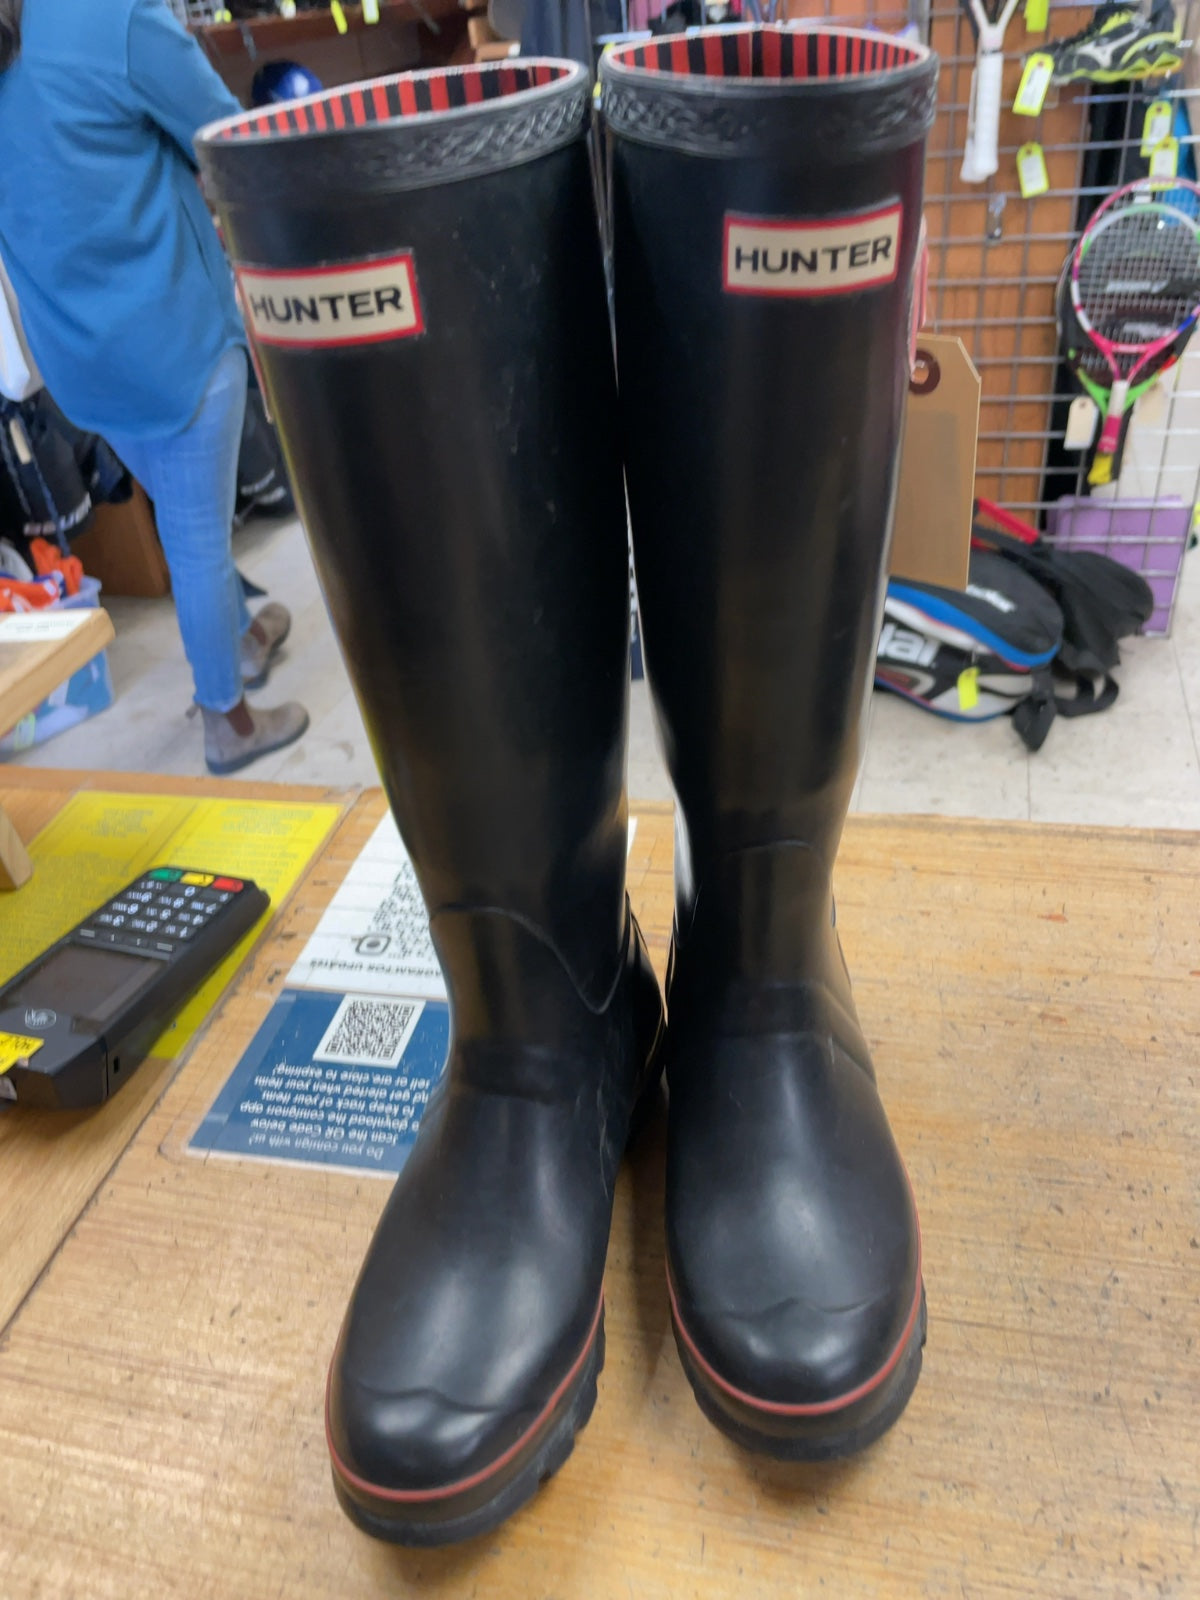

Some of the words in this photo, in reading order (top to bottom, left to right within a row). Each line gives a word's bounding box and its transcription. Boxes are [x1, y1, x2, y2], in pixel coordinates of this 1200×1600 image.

[735, 235, 892, 273] HUNTER
[249, 285, 403, 323] HUNTER
[254, 1075, 283, 1090] items
[325, 1069, 337, 1081] to
[340, 1071, 370, 1085] close
[394, 1076, 408, 1087] or
[285, 1079, 312, 1091] your
[312, 1081, 341, 1096] when
[409, 1077, 430, 1091] sell
[262, 1090, 291, 1105] items
[343, 1084, 387, 1100] alerted
[389, 1088, 411, 1102] get
[240, 1100, 263, 1115] app
[293, 1093, 319, 1107] your
[319, 1095, 333, 1109] of
[336, 1098, 366, 1112] track
[369, 1101, 399, 1117] keep
[402, 1105, 415, 1118] to
[250, 1118, 286, 1133] below
[328, 1111, 347, 1126] the
[348, 1114, 408, 1132] download
[289, 1122, 321, 1138] Code
[325, 1126, 345, 1141] QR
[348, 1128, 367, 1142] the
[268, 1135, 291, 1148] with
[294, 1136, 339, 1152] consign
[371, 1131, 398, 1147] Scan
[341, 1143, 364, 1155] you
[366, 1146, 384, 1161] Do
